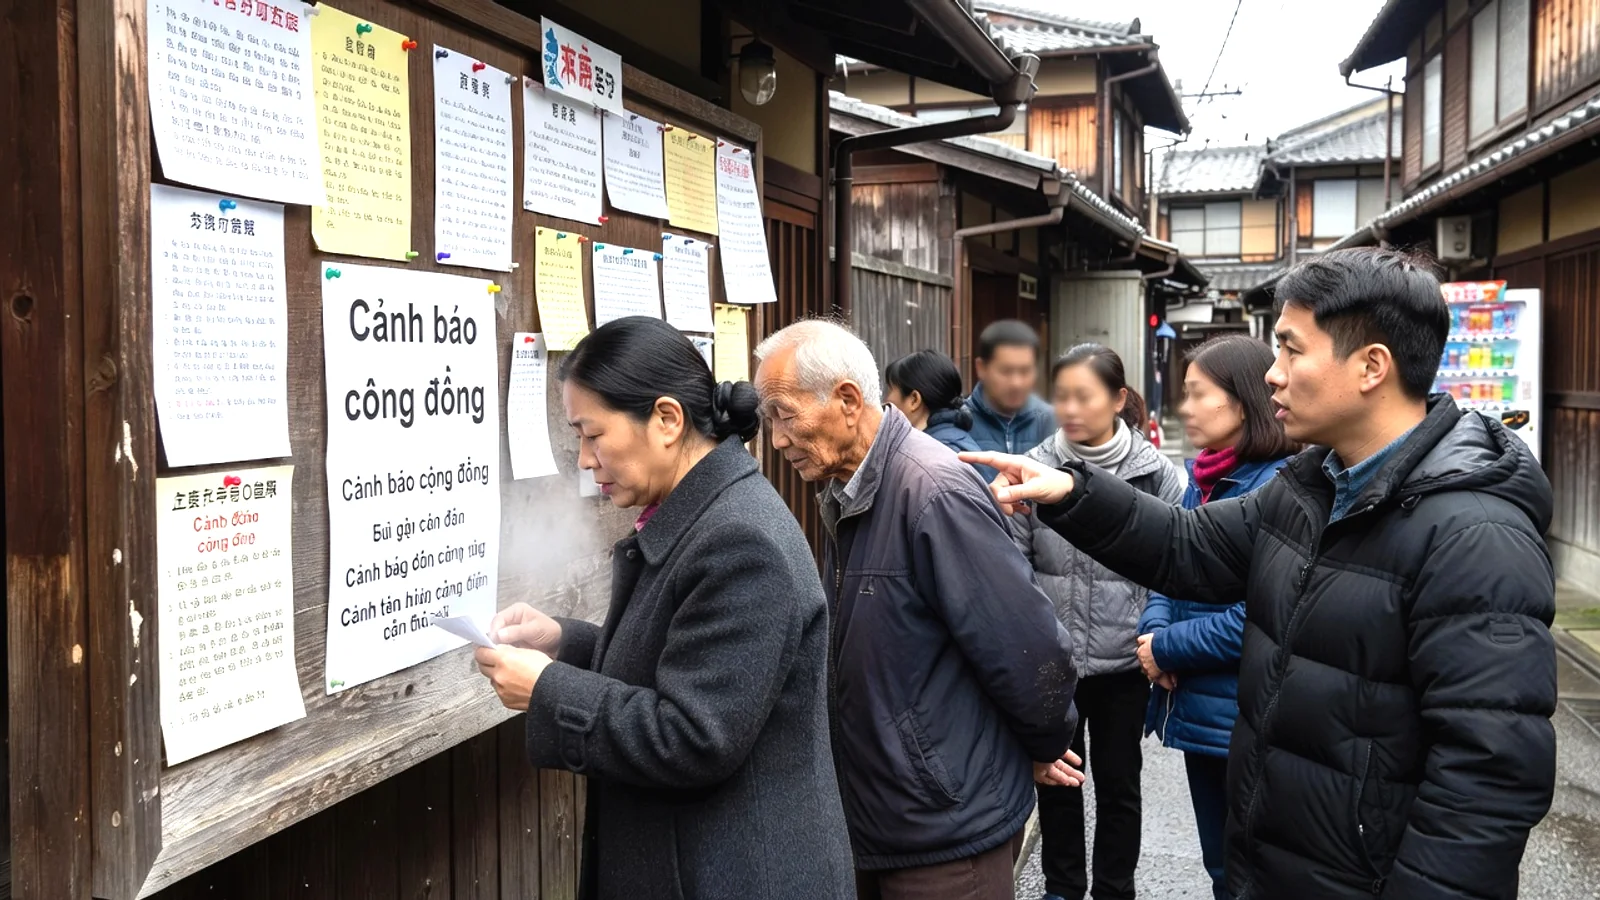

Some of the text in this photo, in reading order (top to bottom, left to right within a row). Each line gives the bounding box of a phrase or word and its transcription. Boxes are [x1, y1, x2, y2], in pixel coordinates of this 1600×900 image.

[349, 298, 478, 345] Cảnh báo
[344, 378, 415, 429] công
[387, 469, 415, 494] báo
